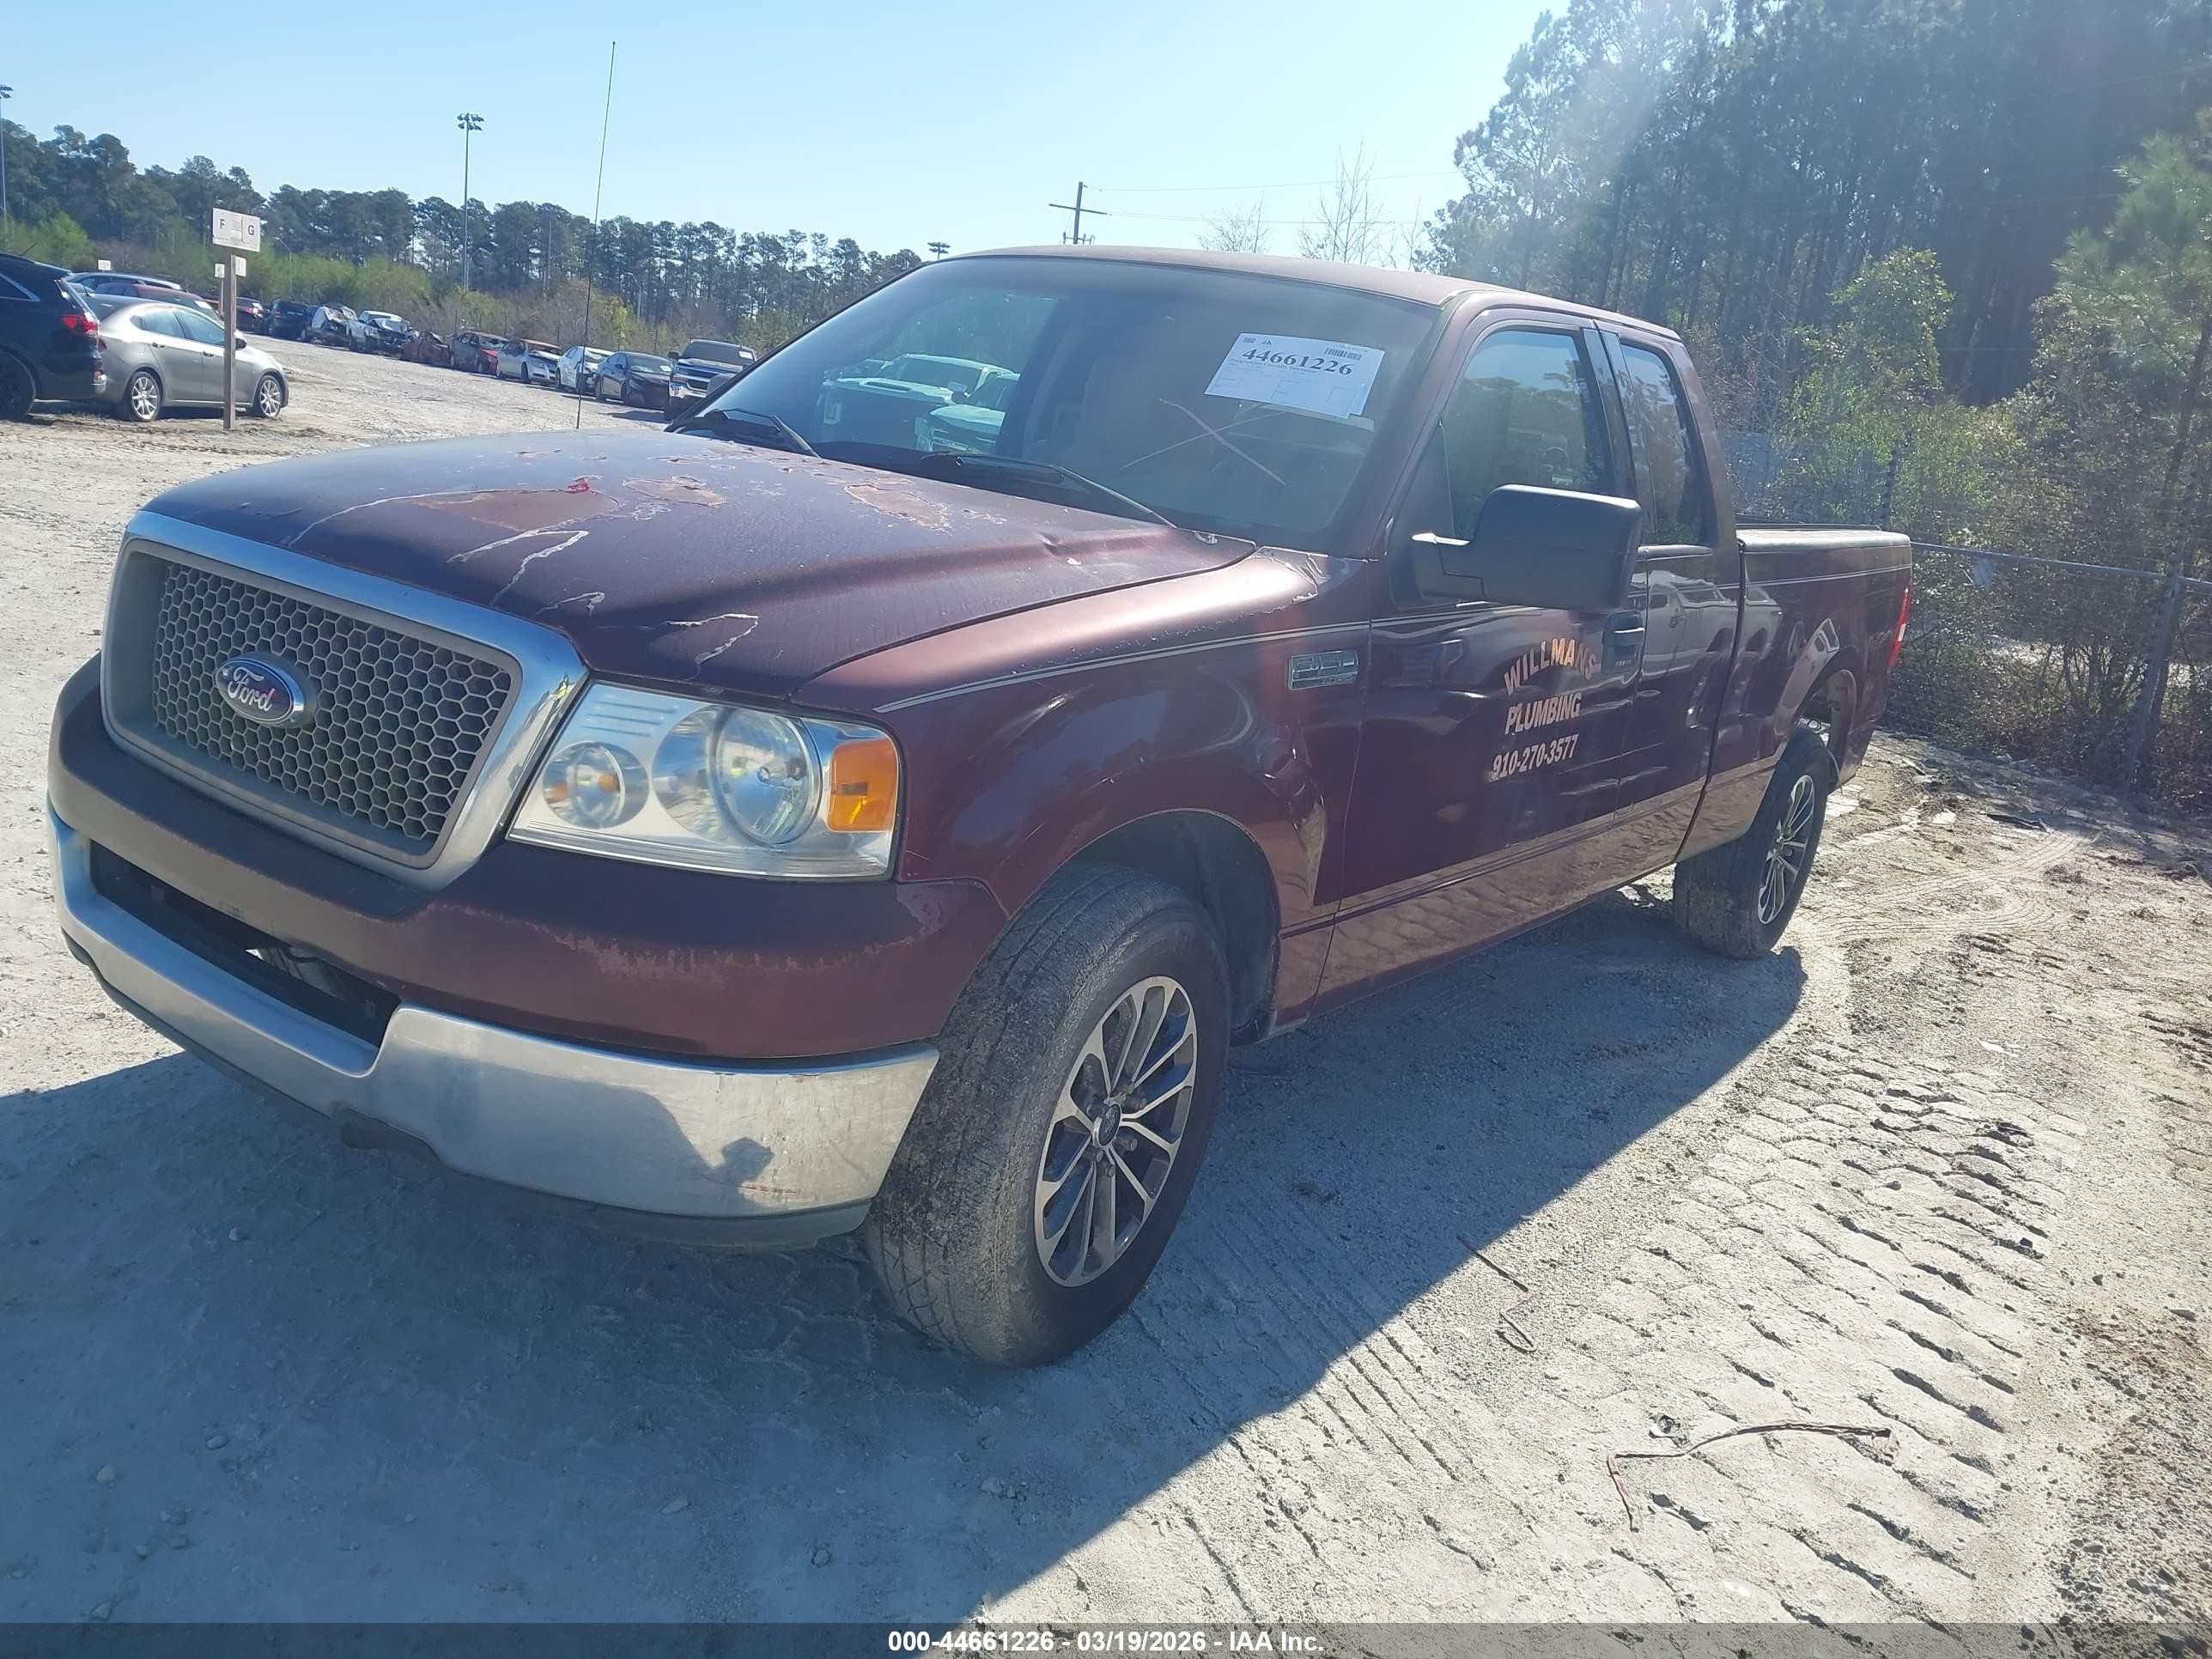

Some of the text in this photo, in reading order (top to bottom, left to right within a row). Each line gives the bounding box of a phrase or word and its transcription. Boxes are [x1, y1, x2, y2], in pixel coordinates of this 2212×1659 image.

[219, 218, 255, 236] F G
[1242, 349, 1354, 375] 44661226
[228, 666, 275, 712] Ford
[1504, 638, 1597, 696] WILLMANS
[1504, 692, 1582, 735] PLUMBING
[1490, 734, 1579, 782] 910-270-3577
